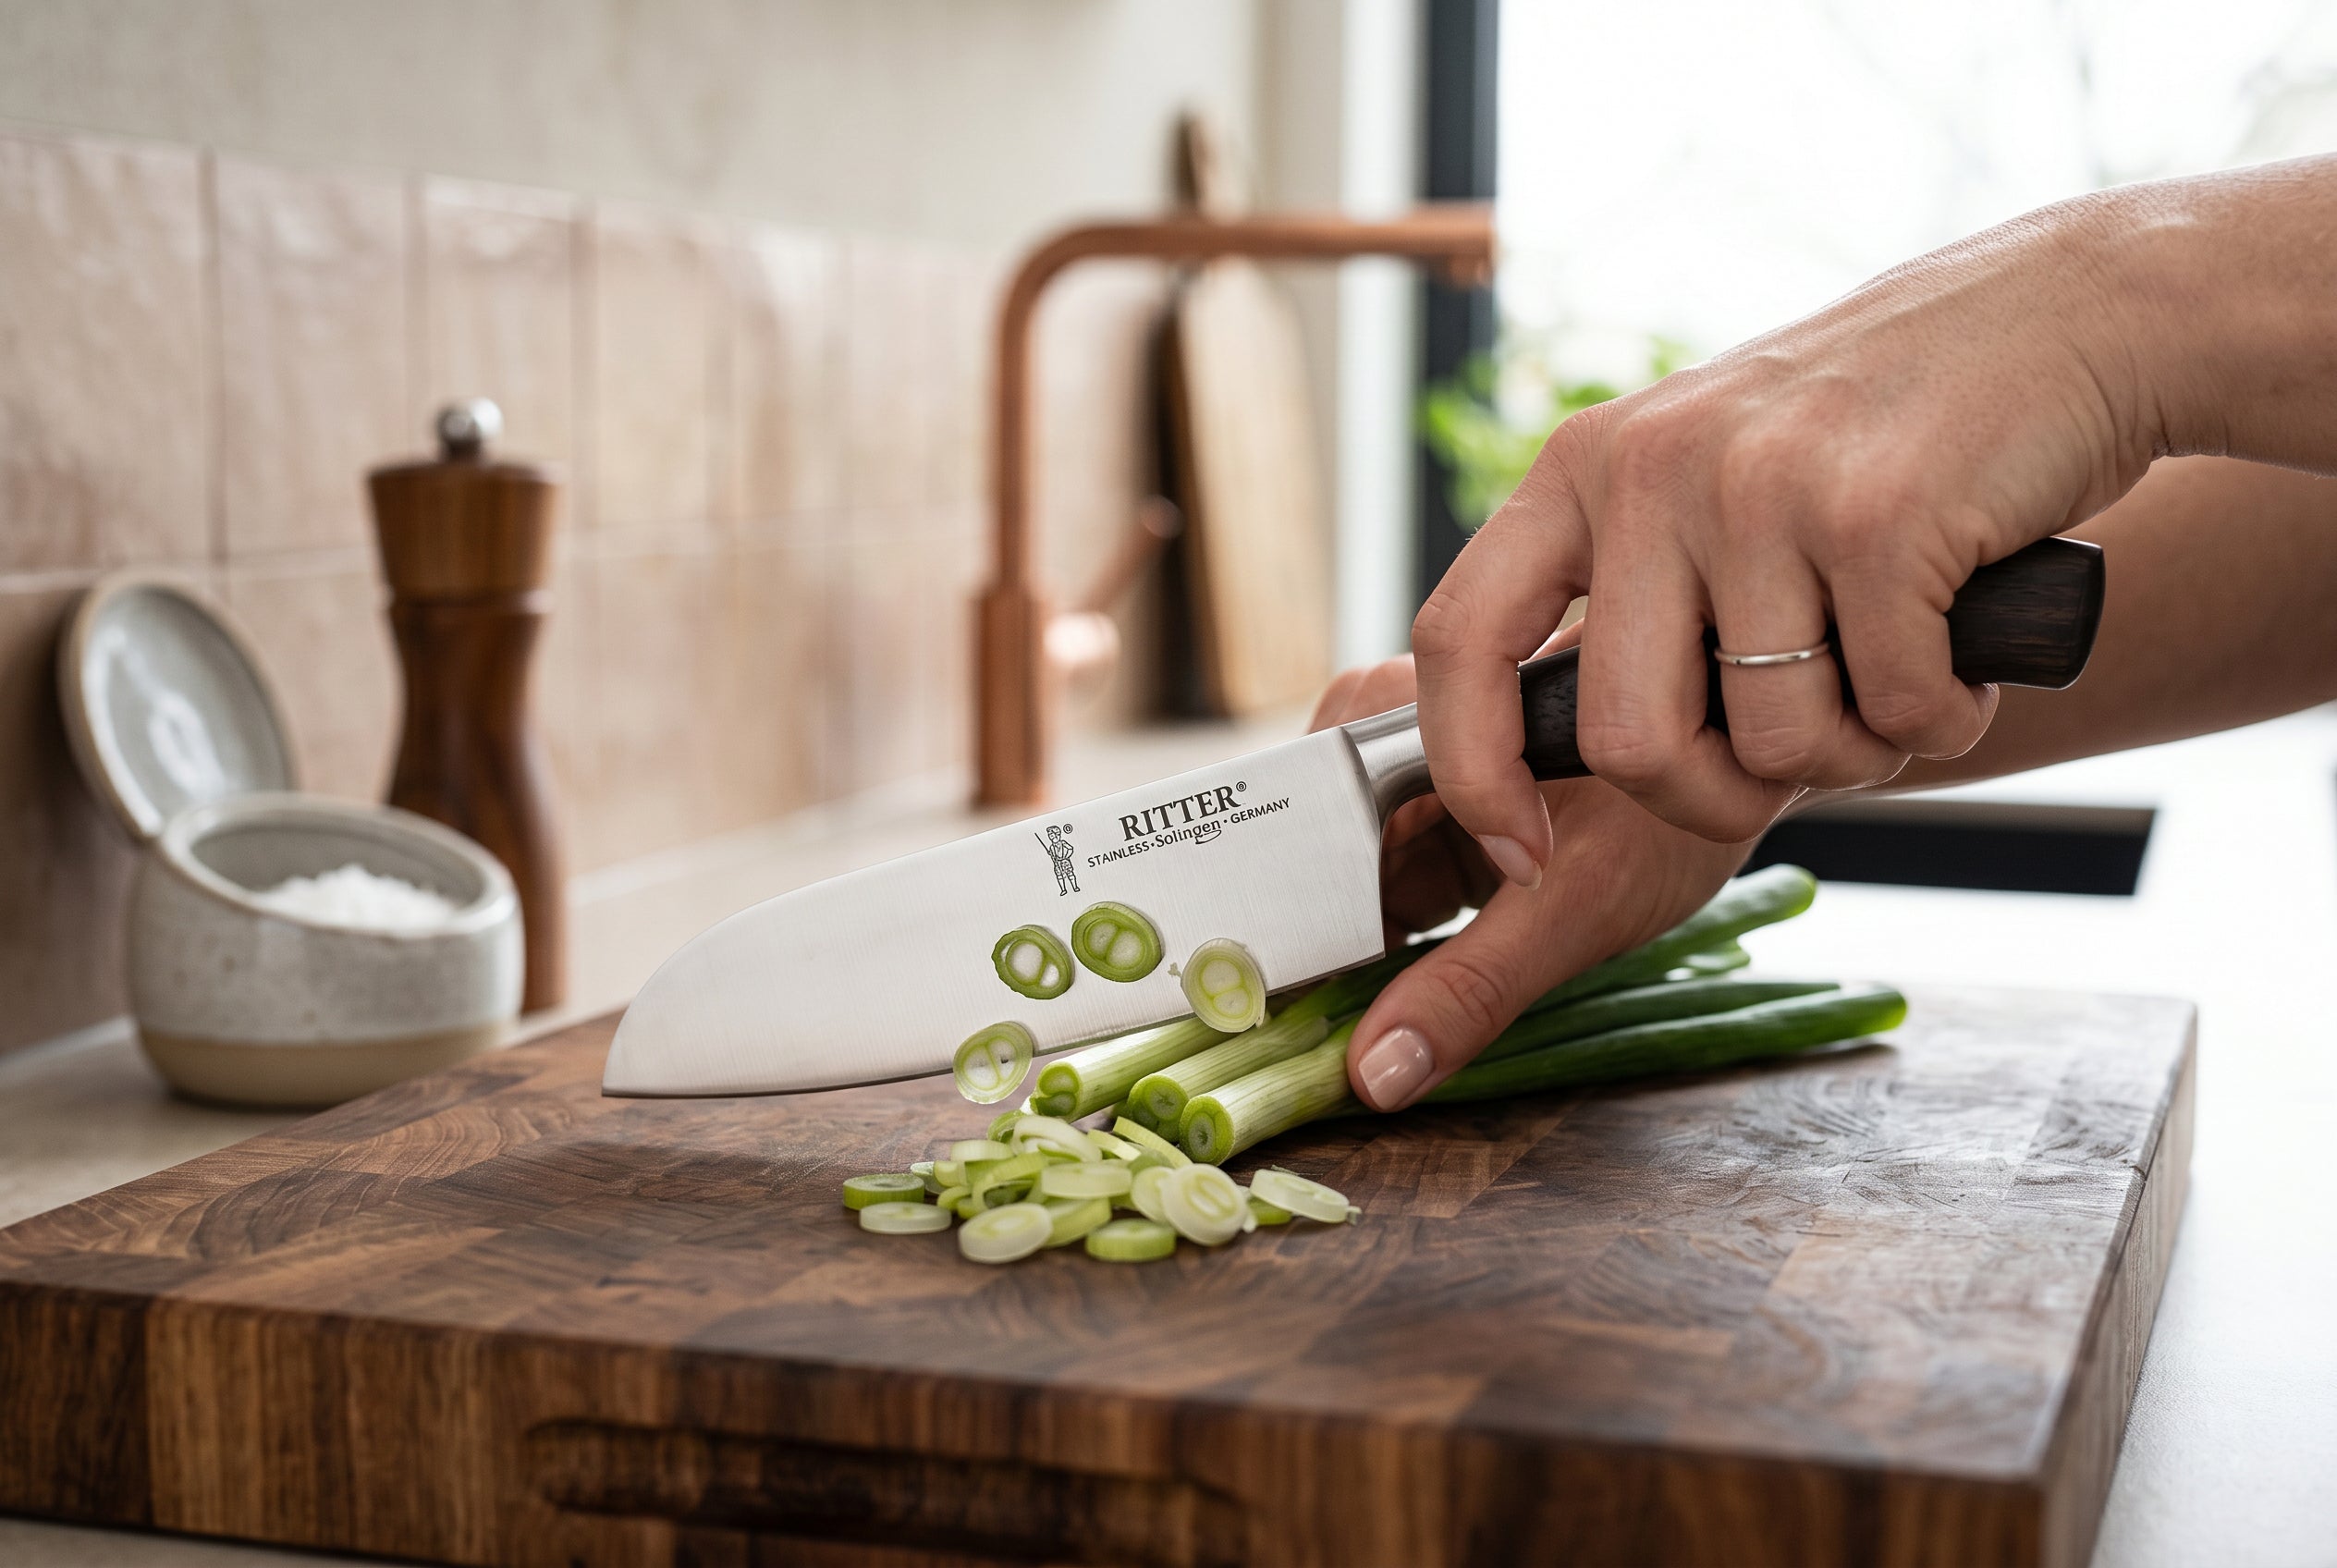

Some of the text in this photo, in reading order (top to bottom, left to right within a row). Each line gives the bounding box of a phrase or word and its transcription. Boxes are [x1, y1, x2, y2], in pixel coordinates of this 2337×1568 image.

[1087, 797, 1290, 868] STAINLESS Solingen GERMANY
